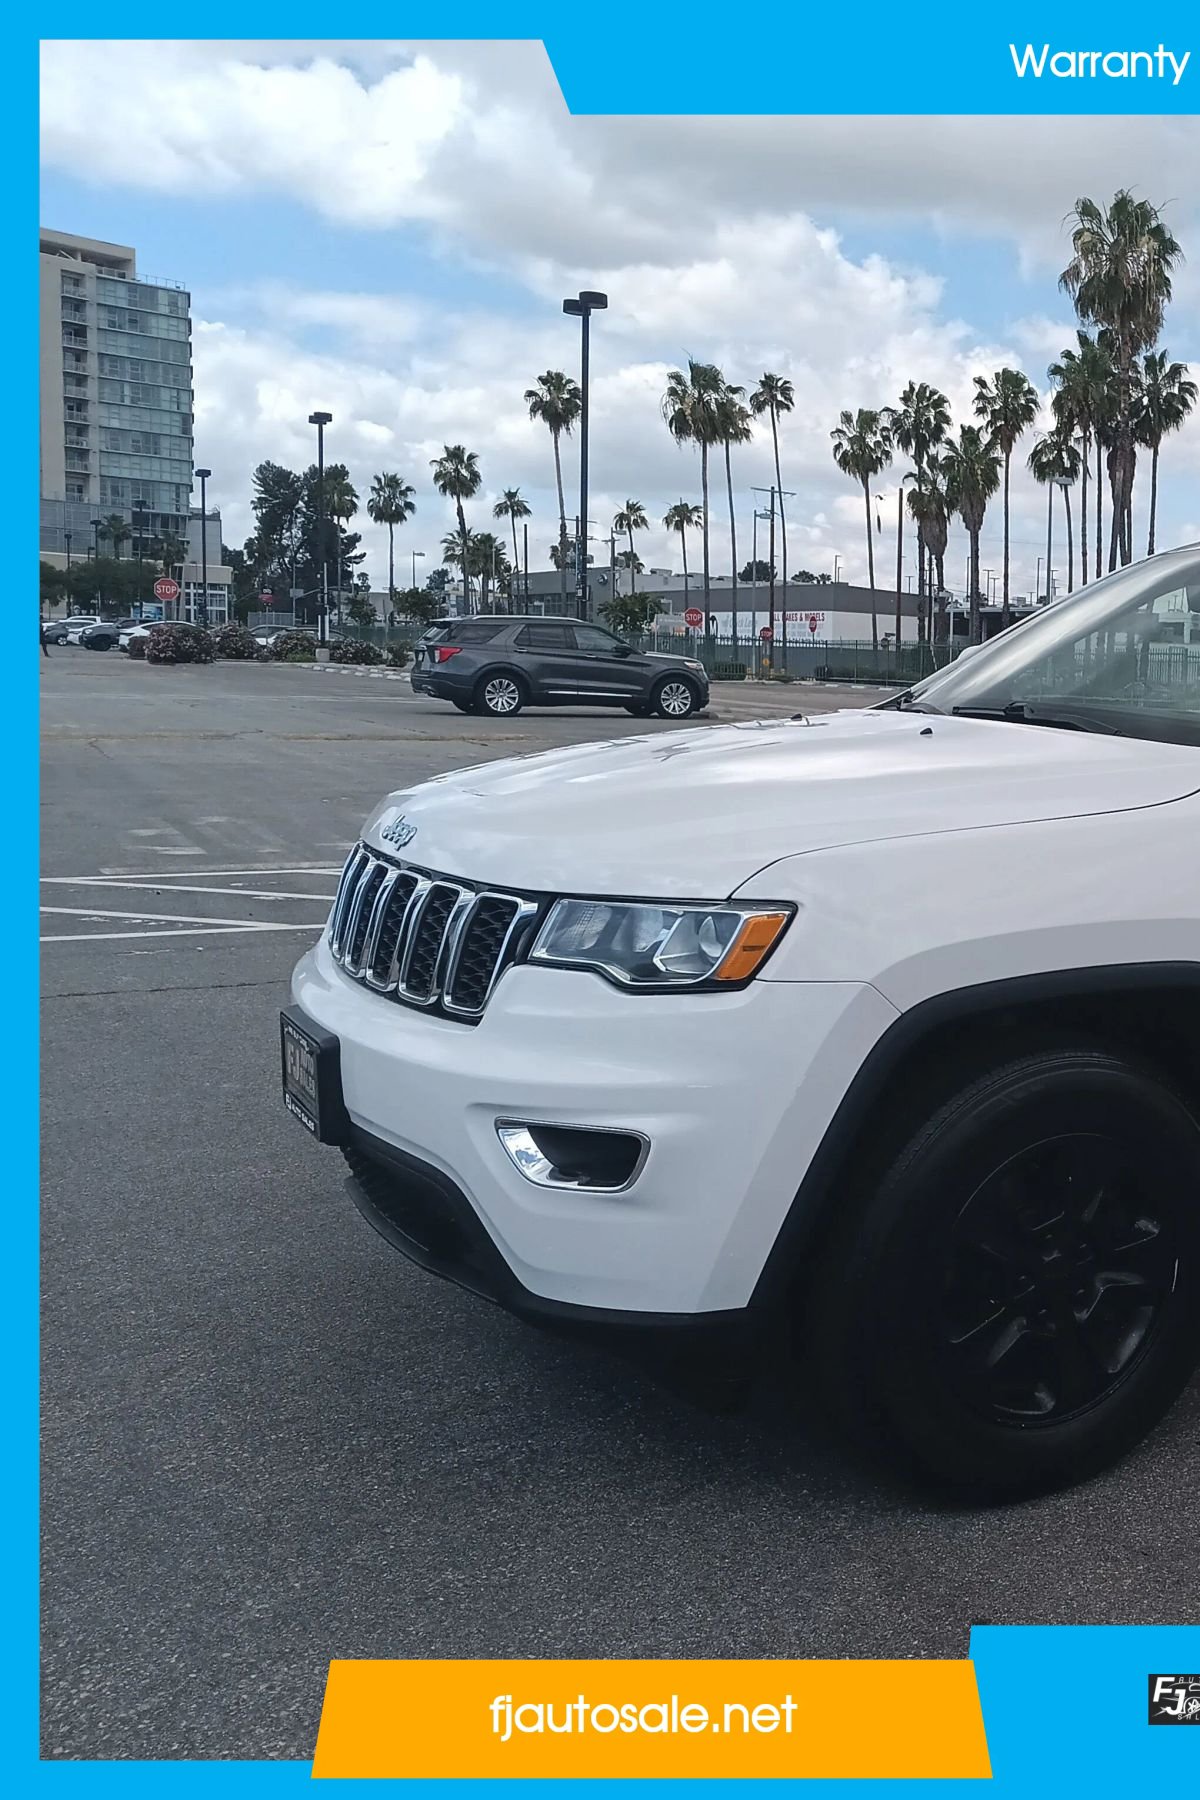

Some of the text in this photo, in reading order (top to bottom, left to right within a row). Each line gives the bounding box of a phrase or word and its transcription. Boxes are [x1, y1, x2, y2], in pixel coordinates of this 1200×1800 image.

[156, 585, 177, 594] STOP
[686, 613, 702, 622] STOP
[782, 612, 798, 622] AKES
[760, 630, 773, 638] STOP
[381, 814, 417, 852] Jeep
